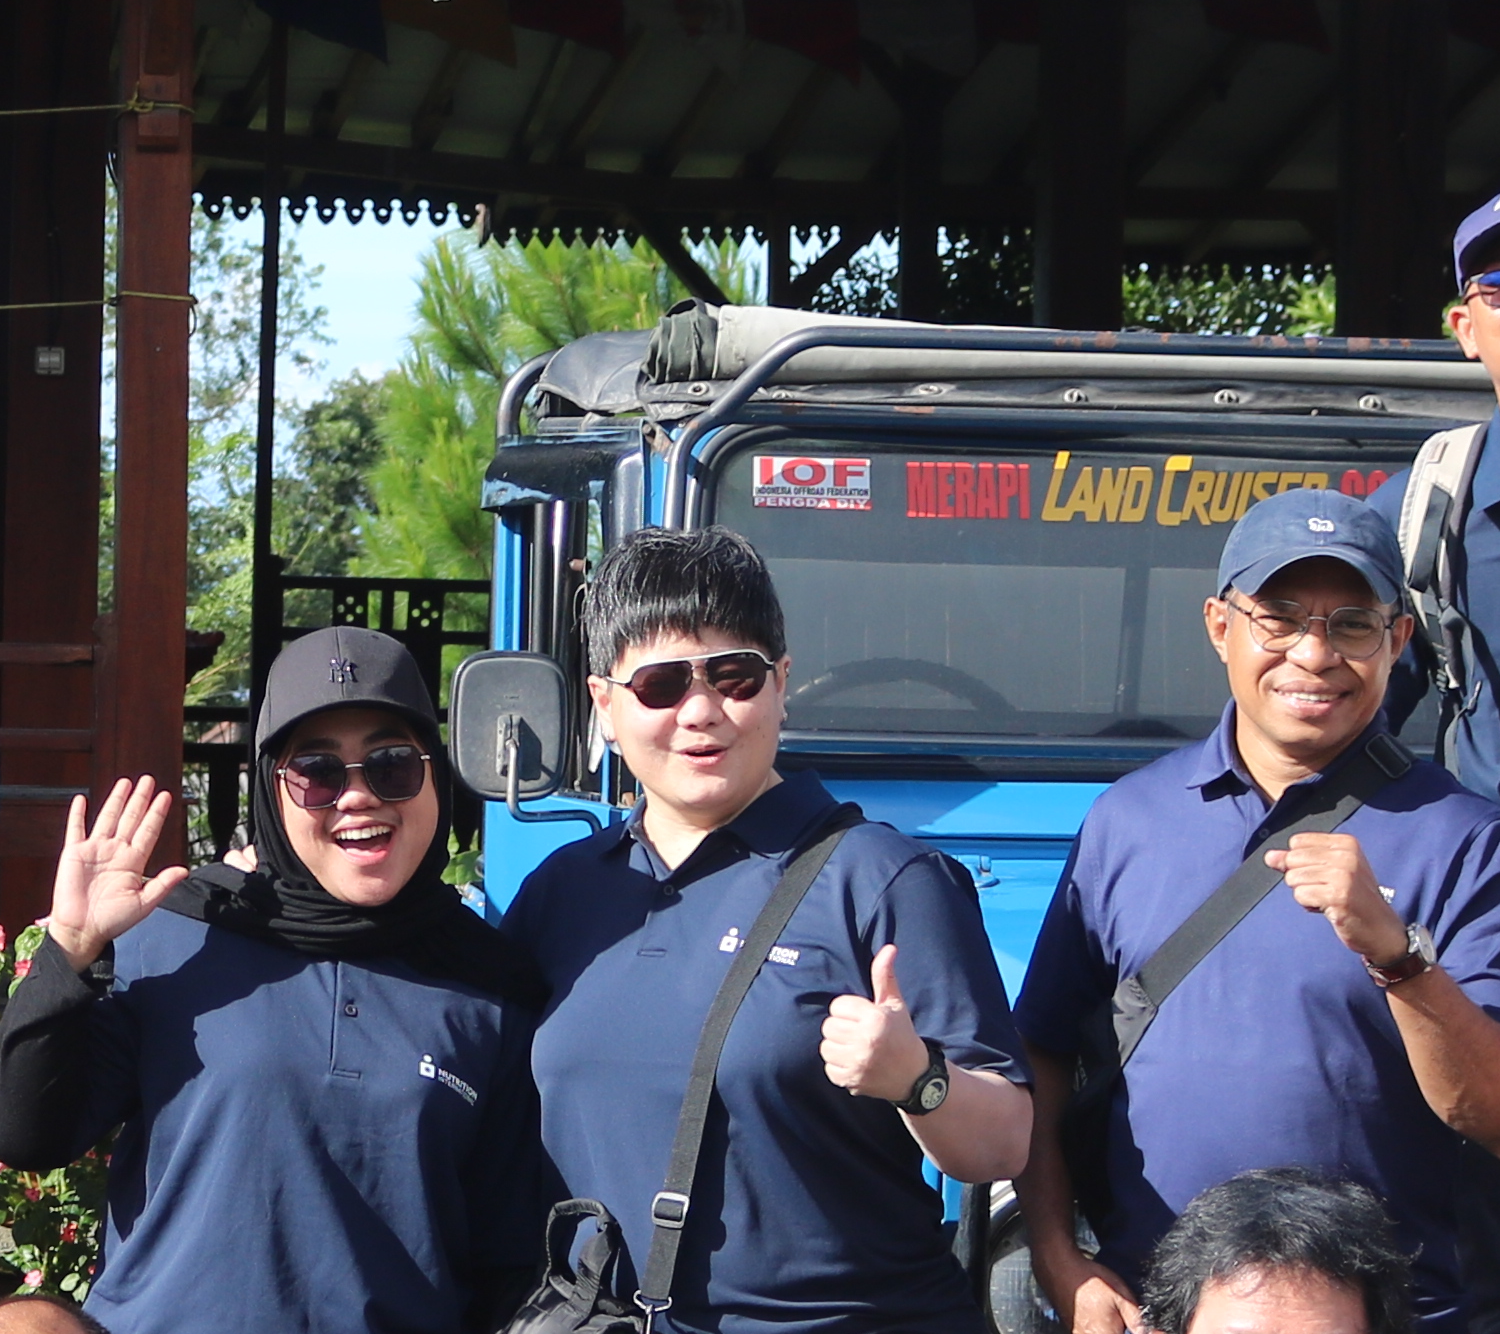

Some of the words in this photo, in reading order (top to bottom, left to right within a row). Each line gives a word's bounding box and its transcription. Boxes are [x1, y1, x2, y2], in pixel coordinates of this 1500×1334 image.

[759, 457, 868, 487] IOF
[906, 461, 1030, 519] MERAPI
[1041, 450, 1154, 522] LAND
[754, 497, 831, 508] PENGDA
[836, 499, 868, 510] DIY
